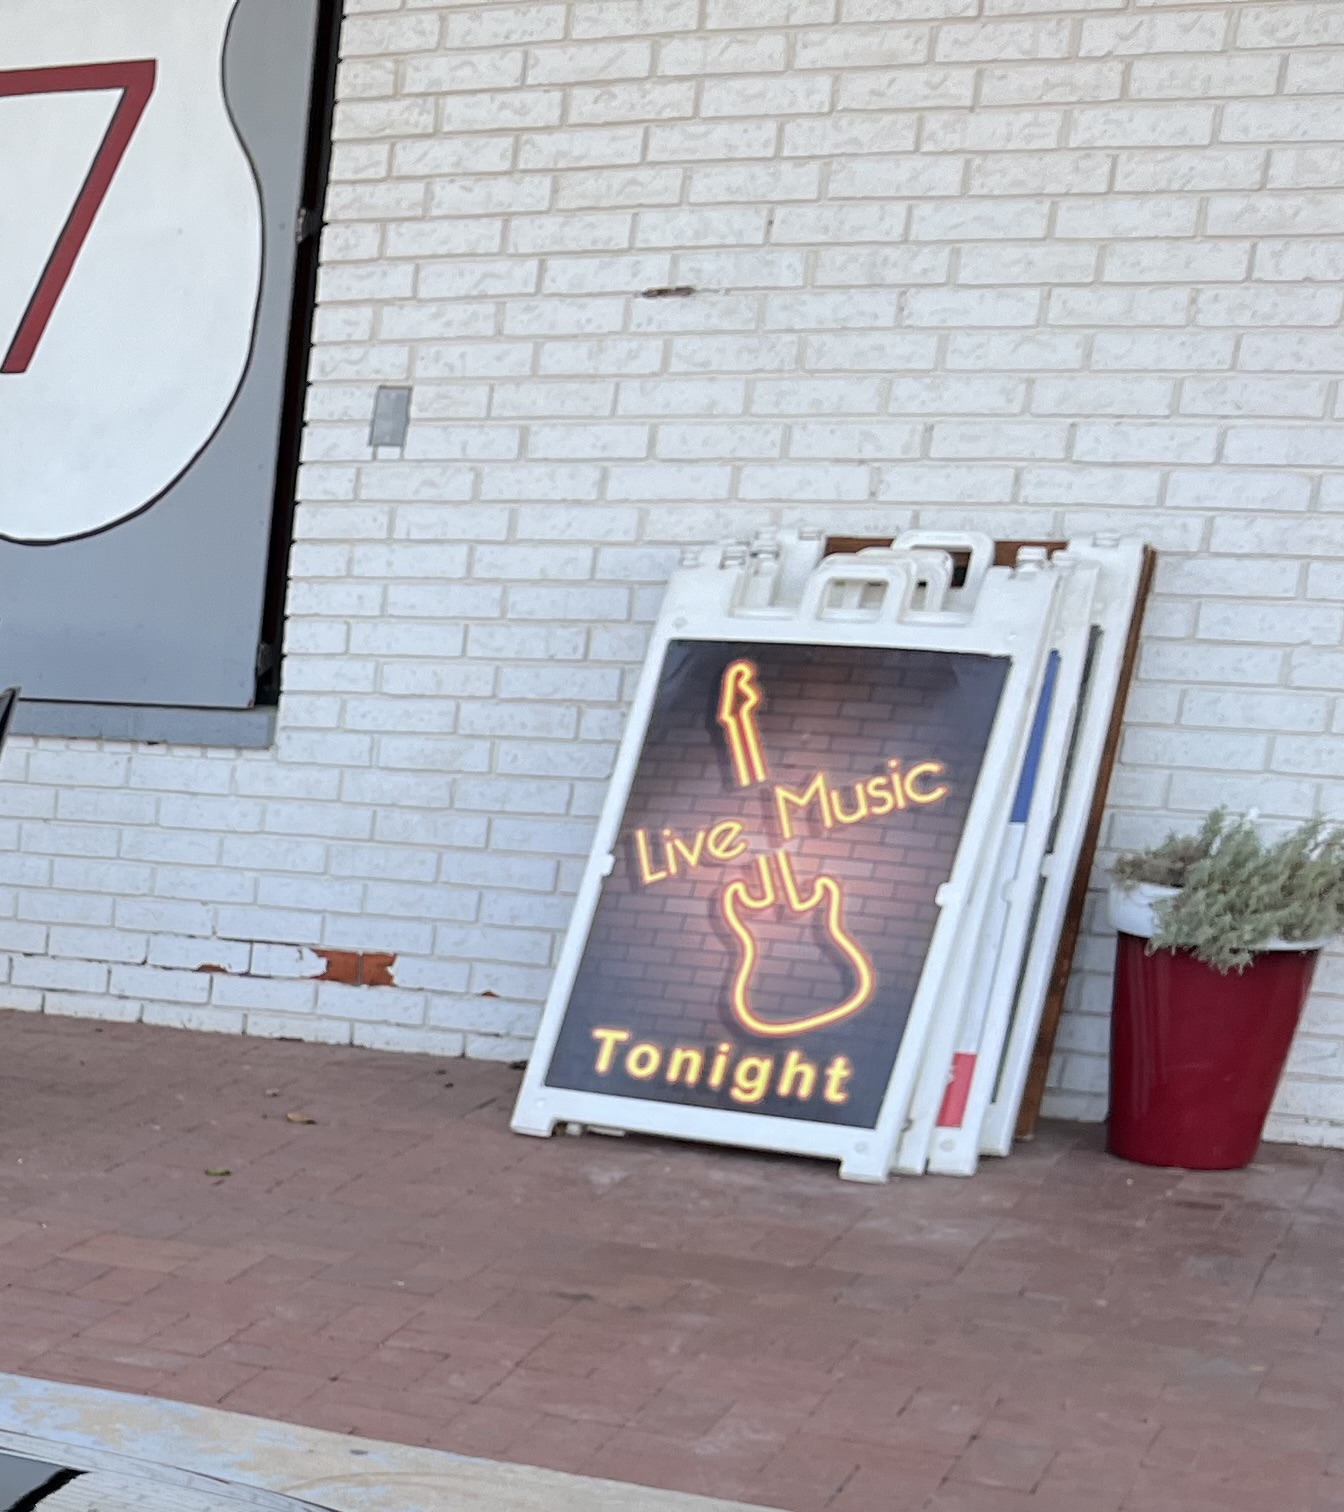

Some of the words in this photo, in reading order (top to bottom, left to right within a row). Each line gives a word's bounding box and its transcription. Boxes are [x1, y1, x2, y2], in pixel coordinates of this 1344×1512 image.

[634, 820, 750, 885] Live
[774, 758, 948, 839] Music
[592, 1027, 854, 1103] Tonight
